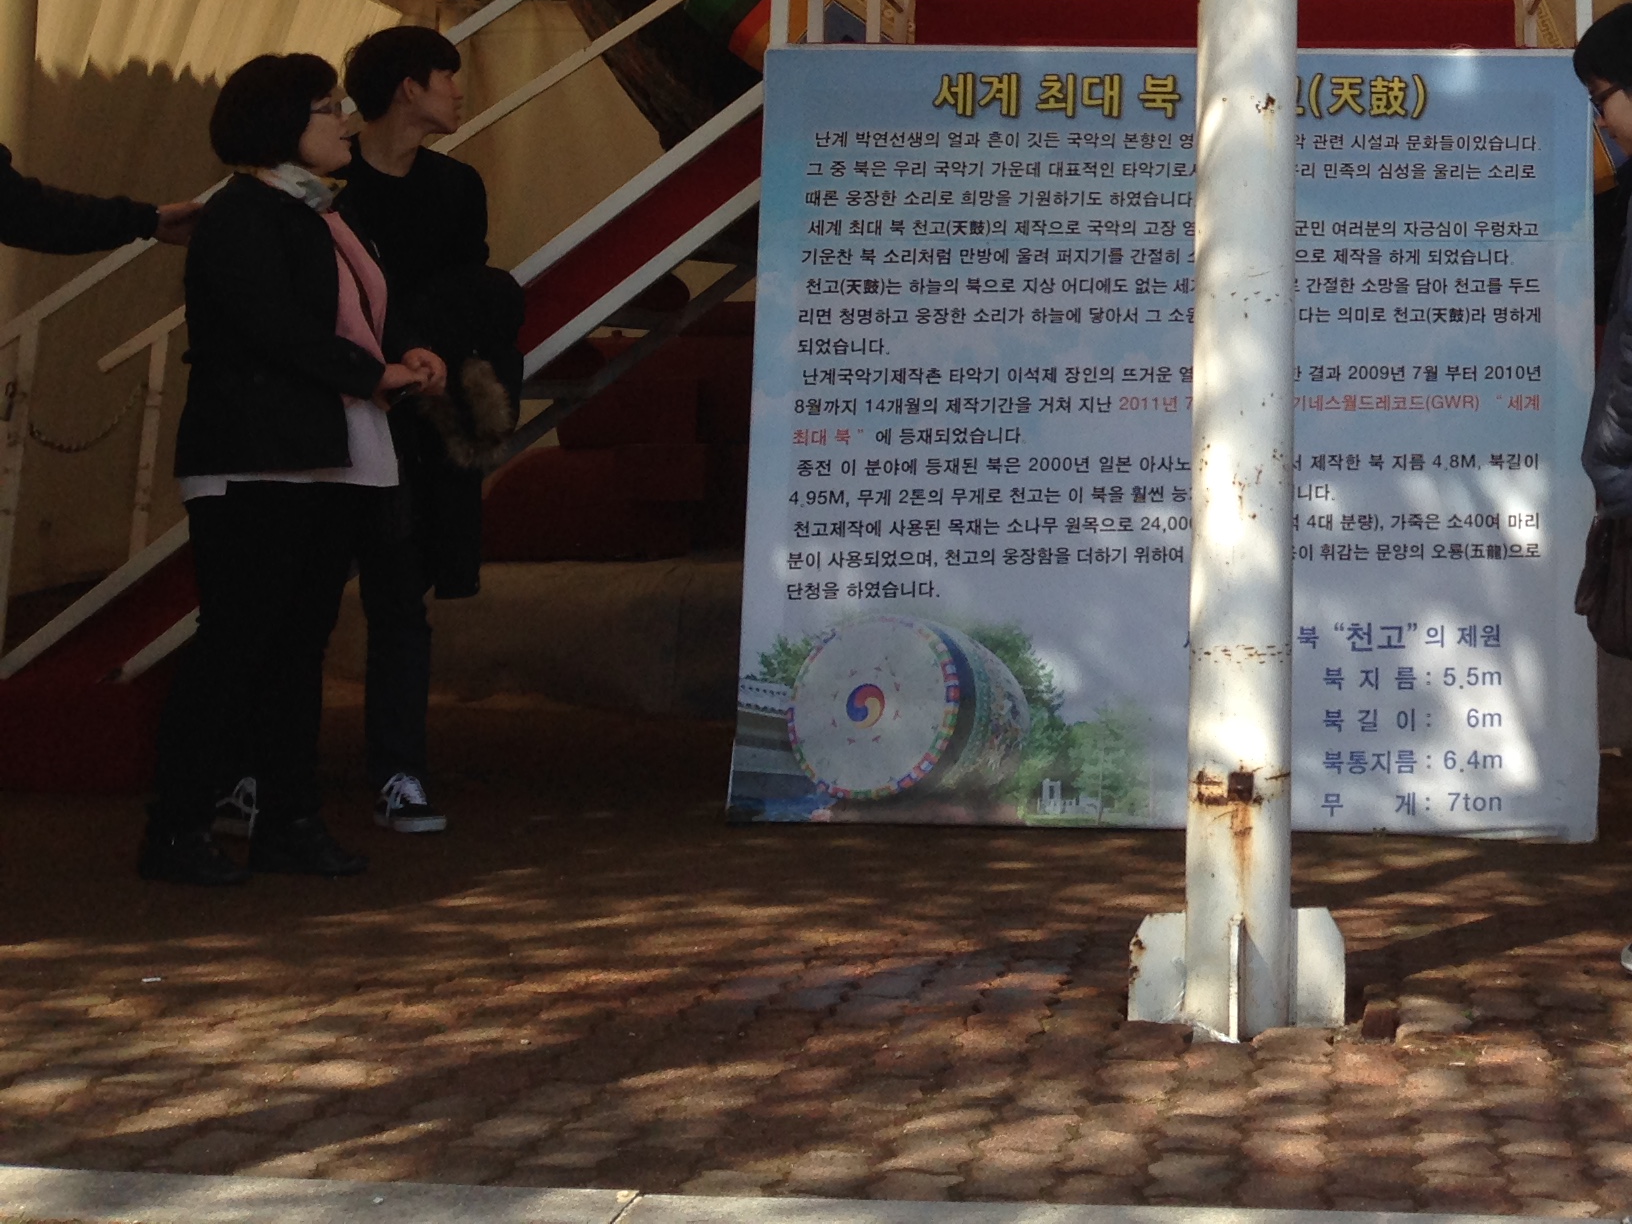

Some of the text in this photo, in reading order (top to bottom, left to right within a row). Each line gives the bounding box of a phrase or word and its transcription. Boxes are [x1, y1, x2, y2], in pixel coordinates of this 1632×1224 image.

[932, 71, 1021, 119] 세계
[1035, 71, 1122, 119] 최대
[1137, 73, 1181, 119] 북
[815, 131, 848, 147] 난계
[855, 131, 940, 148] 박연선생의
[947, 132, 981, 148] 얼과
[1026, 132, 1061, 148] 깃든
[1066, 133, 1116, 149] 국악의
[1122, 133, 1172, 149] 본향인
[1312, 134, 1344, 150] 관련
[1350, 134, 1400, 151] 시설과
[806, 160, 1537, 181] 그 중 북은 우리 국악기 가운데 대표적인 민족의 심성을 울리는 소리로
[805, 190, 840, 207] 때론
[845, 189, 898, 207] 웅장한
[903, 190, 955, 206] 소리로
[960, 190, 1013, 207] 희망을
[1017, 190, 1103, 207] 기원하기도
[807, 219, 843, 236] 세계
[848, 219, 883, 236] 최대
[889, 220, 906, 236] 북
[1013, 220, 1082, 236] 제작으로
[1086, 220, 1137, 236] 국악의
[1142, 220, 1177, 236] 고장
[1331, 220, 1396, 237] 여러분의
[1403, 220, 1468, 238] 자긍심이
[1473, 221, 1539, 238] 우렁차고
[801, 248, 854, 265] 기운찬
[859, 248, 877, 265] 북
[882, 247, 952, 266] 소리처럼
[959, 247, 1010, 264] 만방에
[1015, 247, 1050, 264] 울려
[1055, 248, 1125, 265] 퍼지기를
[1129, 248, 1181, 265] 간절히
[1332, 248, 1383, 265] 제작을
[1388, 249, 1421, 265] 하게
[908, 278, 959, 295] 하늘의
[965, 278, 1017, 294] 북으로
[1021, 277, 1057, 294] 지상
[1061, 277, 1129, 294] 어디에도
[1134, 278, 1169, 294] 없는
[1305, 277, 1356, 294] 간절한
[1360, 277, 1411, 294] 소망을
[1415, 278, 1449, 294] 담아
[1453, 278, 1504, 294] 천고를
[1507, 278, 1541, 294] 두드
[798, 307, 832, 325] 리면
[838, 307, 909, 325] 청명하고
[914, 307, 967, 324] 웅장한
[972, 307, 1025, 324] 소리가
[1031, 306, 1082, 324] 하늘에
[1144, 310, 1163, 322] 그
[1336, 307, 1387, 323] 의미로
[1492, 307, 1542, 323] 명하게
[949, 367, 999, 384] 타악기
[1007, 366, 1058, 384] 이석제
[1064, 366, 1115, 383] 장인의
[1121, 367, 1173, 383] 뜨거운
[1308, 365, 1342, 382] 결과
[1347, 365, 1406, 382] 2009년
[1412, 365, 1438, 382] 7월
[1444, 365, 1478, 382] 부터
[1483, 365, 1542, 381] 2010년
[793, 398, 857, 415] 8월까지
[864, 397, 938, 415] 14개월의
[944, 397, 1033, 414] 제작기간을
[1037, 396, 1072, 414] 거쳐
[1077, 396, 1113, 413] 지난
[1118, 396, 1178, 412] 2011년
[792, 429, 827, 446] 최대
[875, 428, 892, 445] 에
[796, 460, 832, 477] 종전
[840, 459, 857, 477] 이
[863, 458, 918, 476] 분야에
[924, 457, 978, 476] 등재된
[985, 457, 1022, 474] 북은
[1028, 456, 1090, 474] 2000년
[1098, 456, 1133, 473] 일본
[1309, 454, 1362, 471] 제작한
[1368, 454, 1385, 471] 북
[1391, 453, 1426, 471] 지름
[1488, 453, 1539, 470] 북길이
[856, 489, 892, 507] 무게
[898, 488, 944, 506] 2톤의
[950, 487, 1004, 506] 무게로
[1009, 486, 1062, 504] 천고는
[1068, 486, 1084, 504] 이
[1090, 486, 1125, 504] 북을
[1130, 485, 1165, 504] 훨씬
[793, 519, 882, 538] 천고제작에
[888, 518, 941, 537] 사용된
[947, 518, 1001, 536] 목재는
[1006, 517, 1059, 535] 소나무
[1064, 516, 1135, 535] 원목으로
[1306, 514, 1334, 531] 4대
[1390, 513, 1441, 531] 가죽은
[1446, 513, 1501, 530] 소40여
[1507, 512, 1540, 529] 마리
[786, 551, 821, 571] 분이
[826, 550, 938, 569] 사용되었으며,
[944, 548, 996, 566] 천고의
[1001, 547, 1072, 566] 웅장함을
[1076, 546, 1127, 565] 더하기
[1133, 546, 1184, 564] 위하여
[1319, 543, 1370, 561] 휘감는
[1375, 543, 1425, 561] 문양의
[786, 580, 940, 600] 단청을 하였습니다.
[1297, 626, 1319, 649] 북
[1457, 624, 1501, 648] 제원
[1443, 667, 1501, 690] 5.5m
[1467, 708, 1501, 728] 6m
[1443, 750, 1502, 773] 6.4m
[1448, 792, 1501, 813] 7ton
